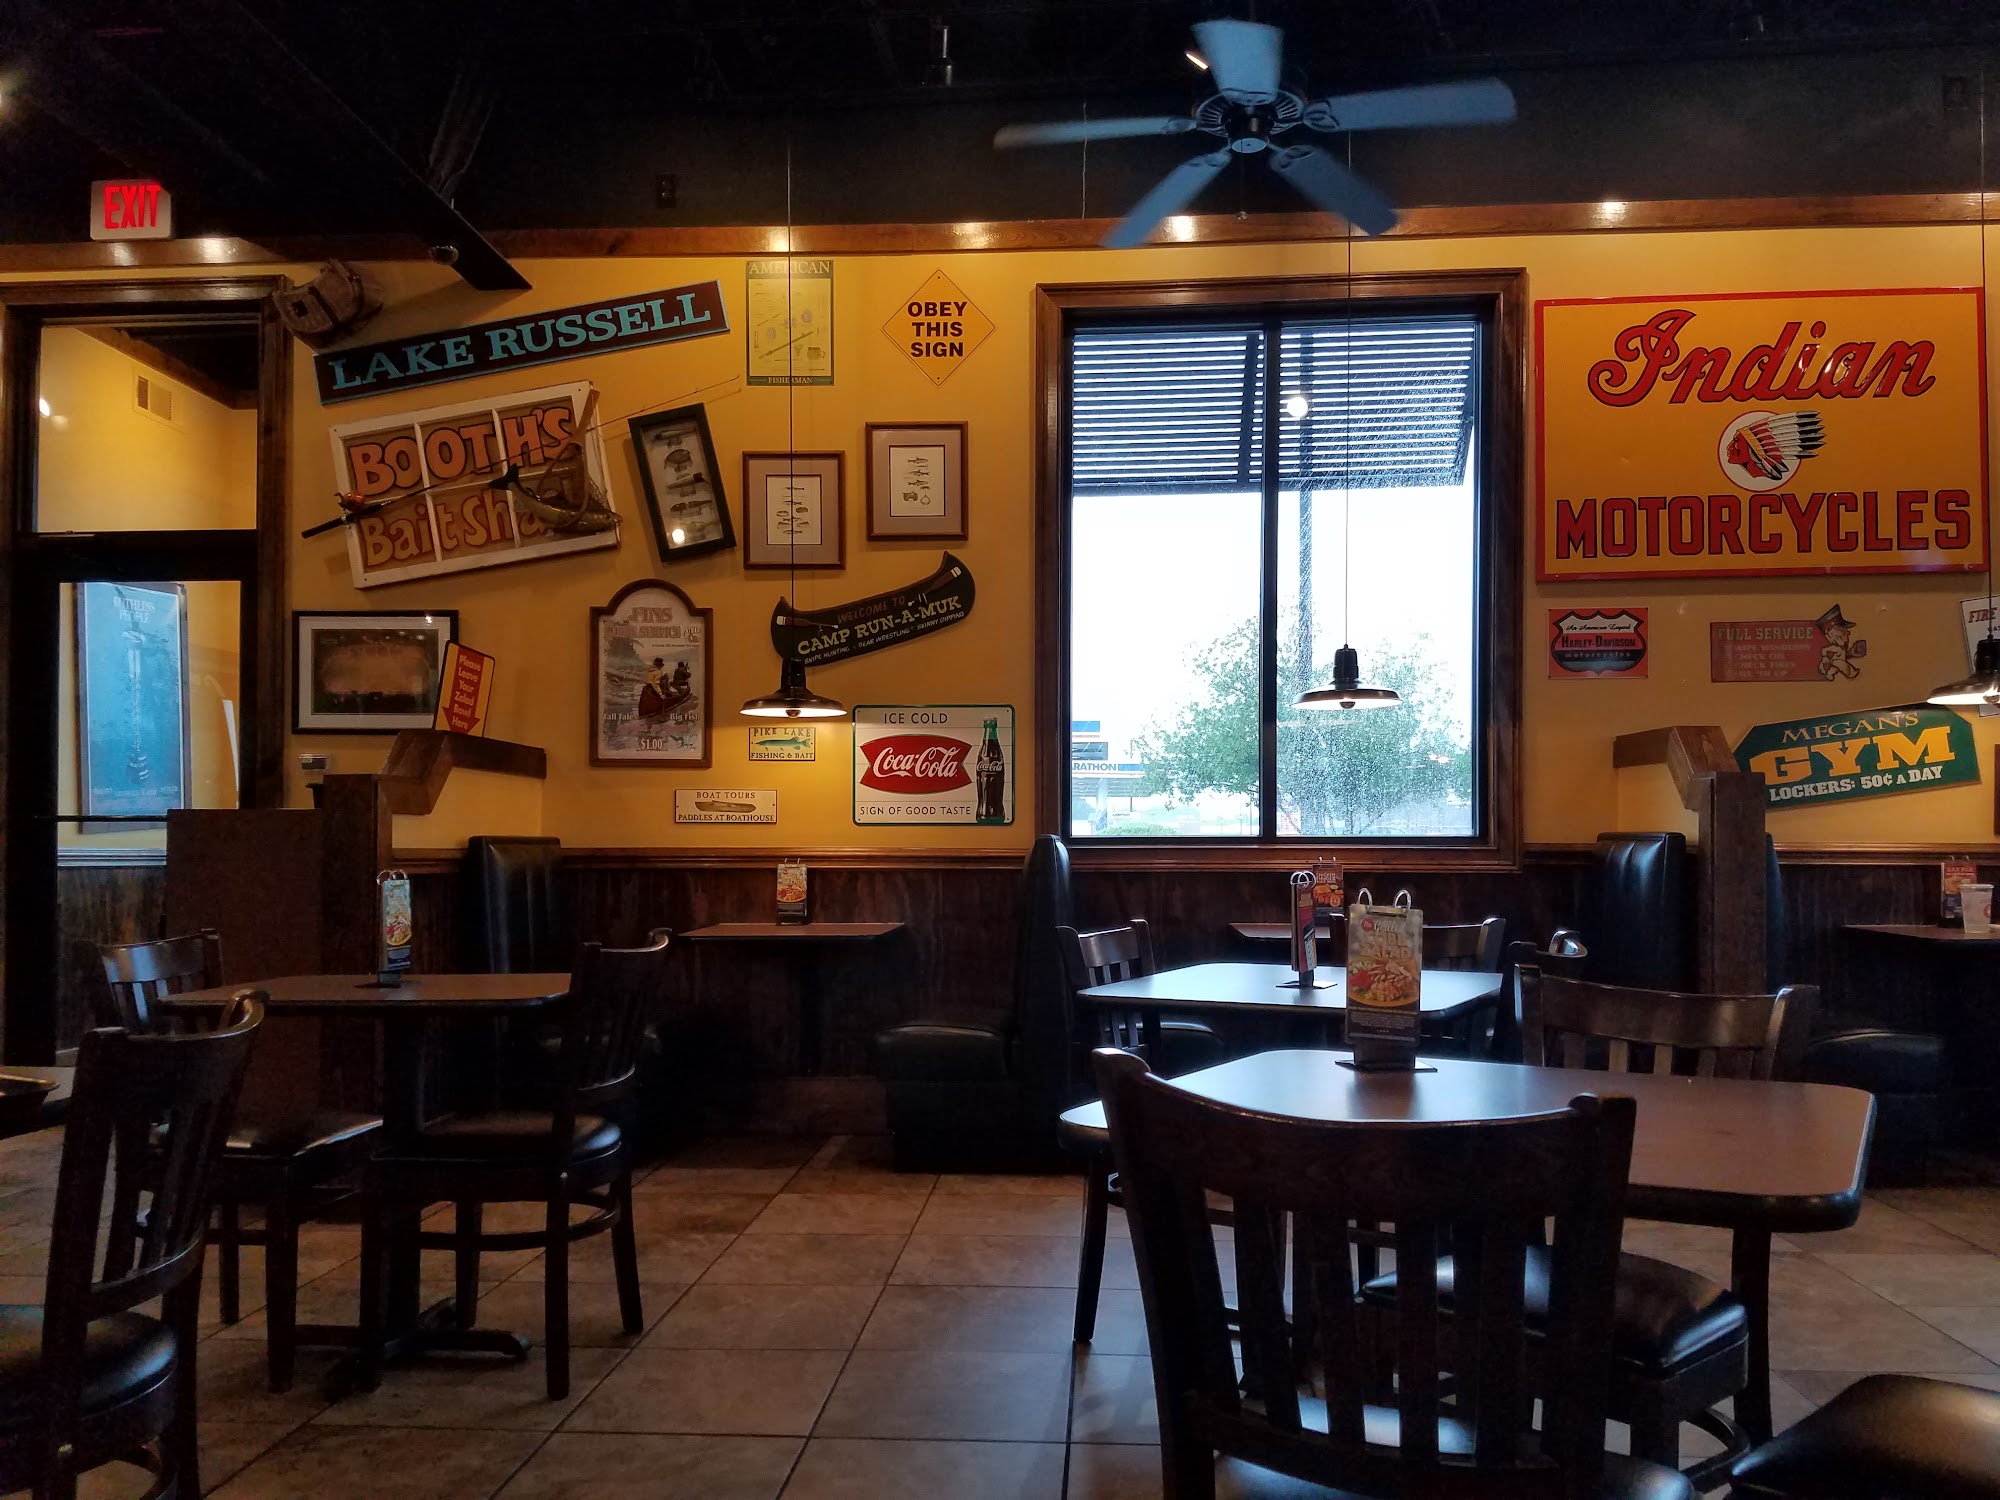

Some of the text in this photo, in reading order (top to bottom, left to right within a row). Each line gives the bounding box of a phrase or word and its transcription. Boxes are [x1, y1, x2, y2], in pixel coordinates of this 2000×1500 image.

[104, 182, 161, 229] EXIT
[749, 261, 830, 274] AMERICAN
[907, 301, 968, 317] OBEY
[911, 322, 964, 337] THIS
[328, 293, 710, 391] LAKE RUSSELL
[910, 341, 964, 358] SIGN
[1587, 308, 1936, 407] Indian
[348, 407, 572, 497] BOOTH'S
[360, 488, 549, 568] Bait Sha
[1556, 489, 1971, 560] MOTORCYCLES
[631, 607, 673, 623] FINS
[837, 595, 906, 624] WELCOME TO
[1968, 607, 1998, 623] FIRE
[797, 595, 962, 656] CAMP RUN-A-MUK
[1717, 627, 1814, 640] FULL SERVICE
[804, 611, 965, 665] SNIPE HUNTING BEAR WRESTLING SKINNY DIPPING
[1561, 635, 1636, 648] HARLEY-DAVIDSON
[459, 655, 481, 672] Please
[458, 667, 479, 682] Leave
[459, 680, 475, 693] Your
[454, 691, 475, 706] Zalad
[453, 704, 472, 718] Bowl
[670, 713, 683, 721] Big
[884, 713, 948, 725] ICE COLD
[451, 715, 469, 730] Here
[1782, 711, 1919, 743] MEGAN'S
[754, 728, 811, 737] PIKE LAKE
[641, 738, 662, 750] $1.00
[873, 745, 959, 779] Coca-Cola
[1749, 725, 1956, 785] GYM
[1860, 774, 1893, 791] 50¢
[1896, 775, 1907, 785] A
[1907, 765, 1943, 782] DAY
[860, 805, 971, 817] SIGN OF GOOD TASTE
